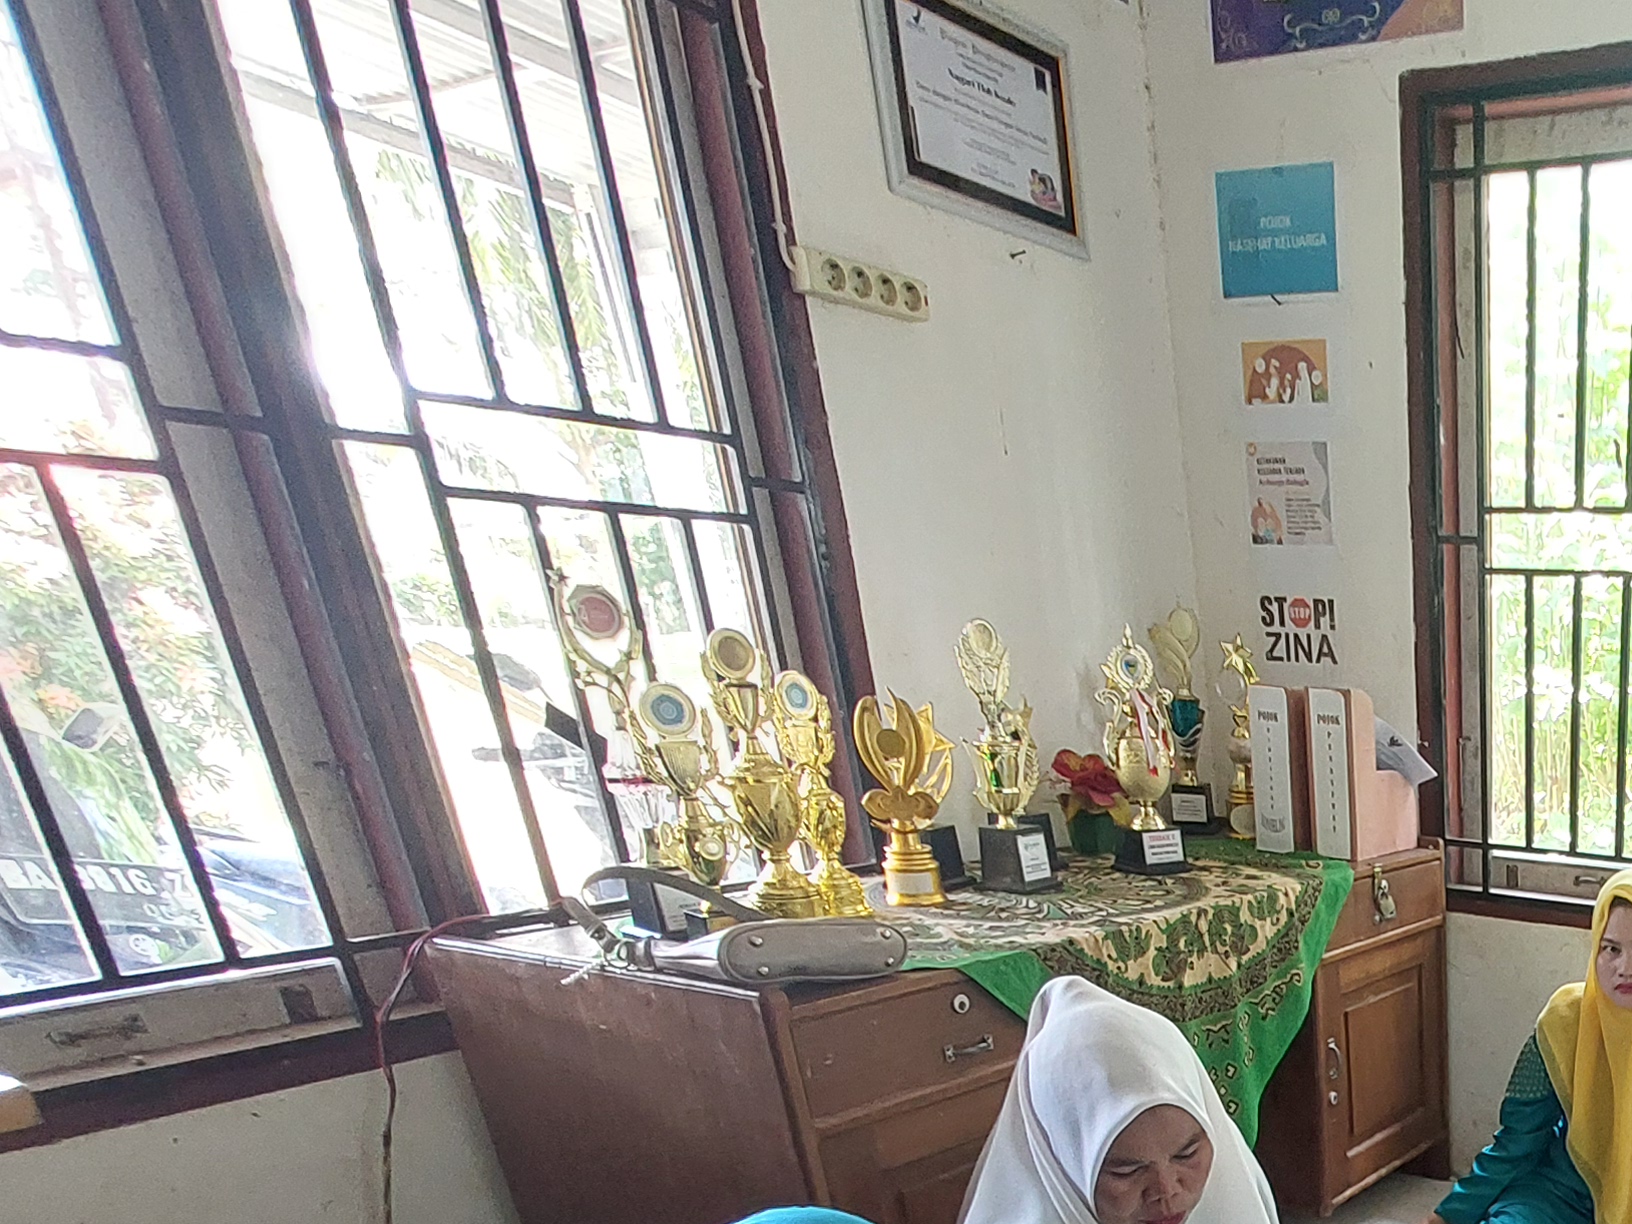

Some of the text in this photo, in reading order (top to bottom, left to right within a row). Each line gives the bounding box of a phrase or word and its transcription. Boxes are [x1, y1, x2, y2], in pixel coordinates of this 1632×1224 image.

[1265, 632, 1338, 664] ZINA
[1258, 710, 1278, 722] POJOK
[1317, 714, 1340, 725] POJOK
